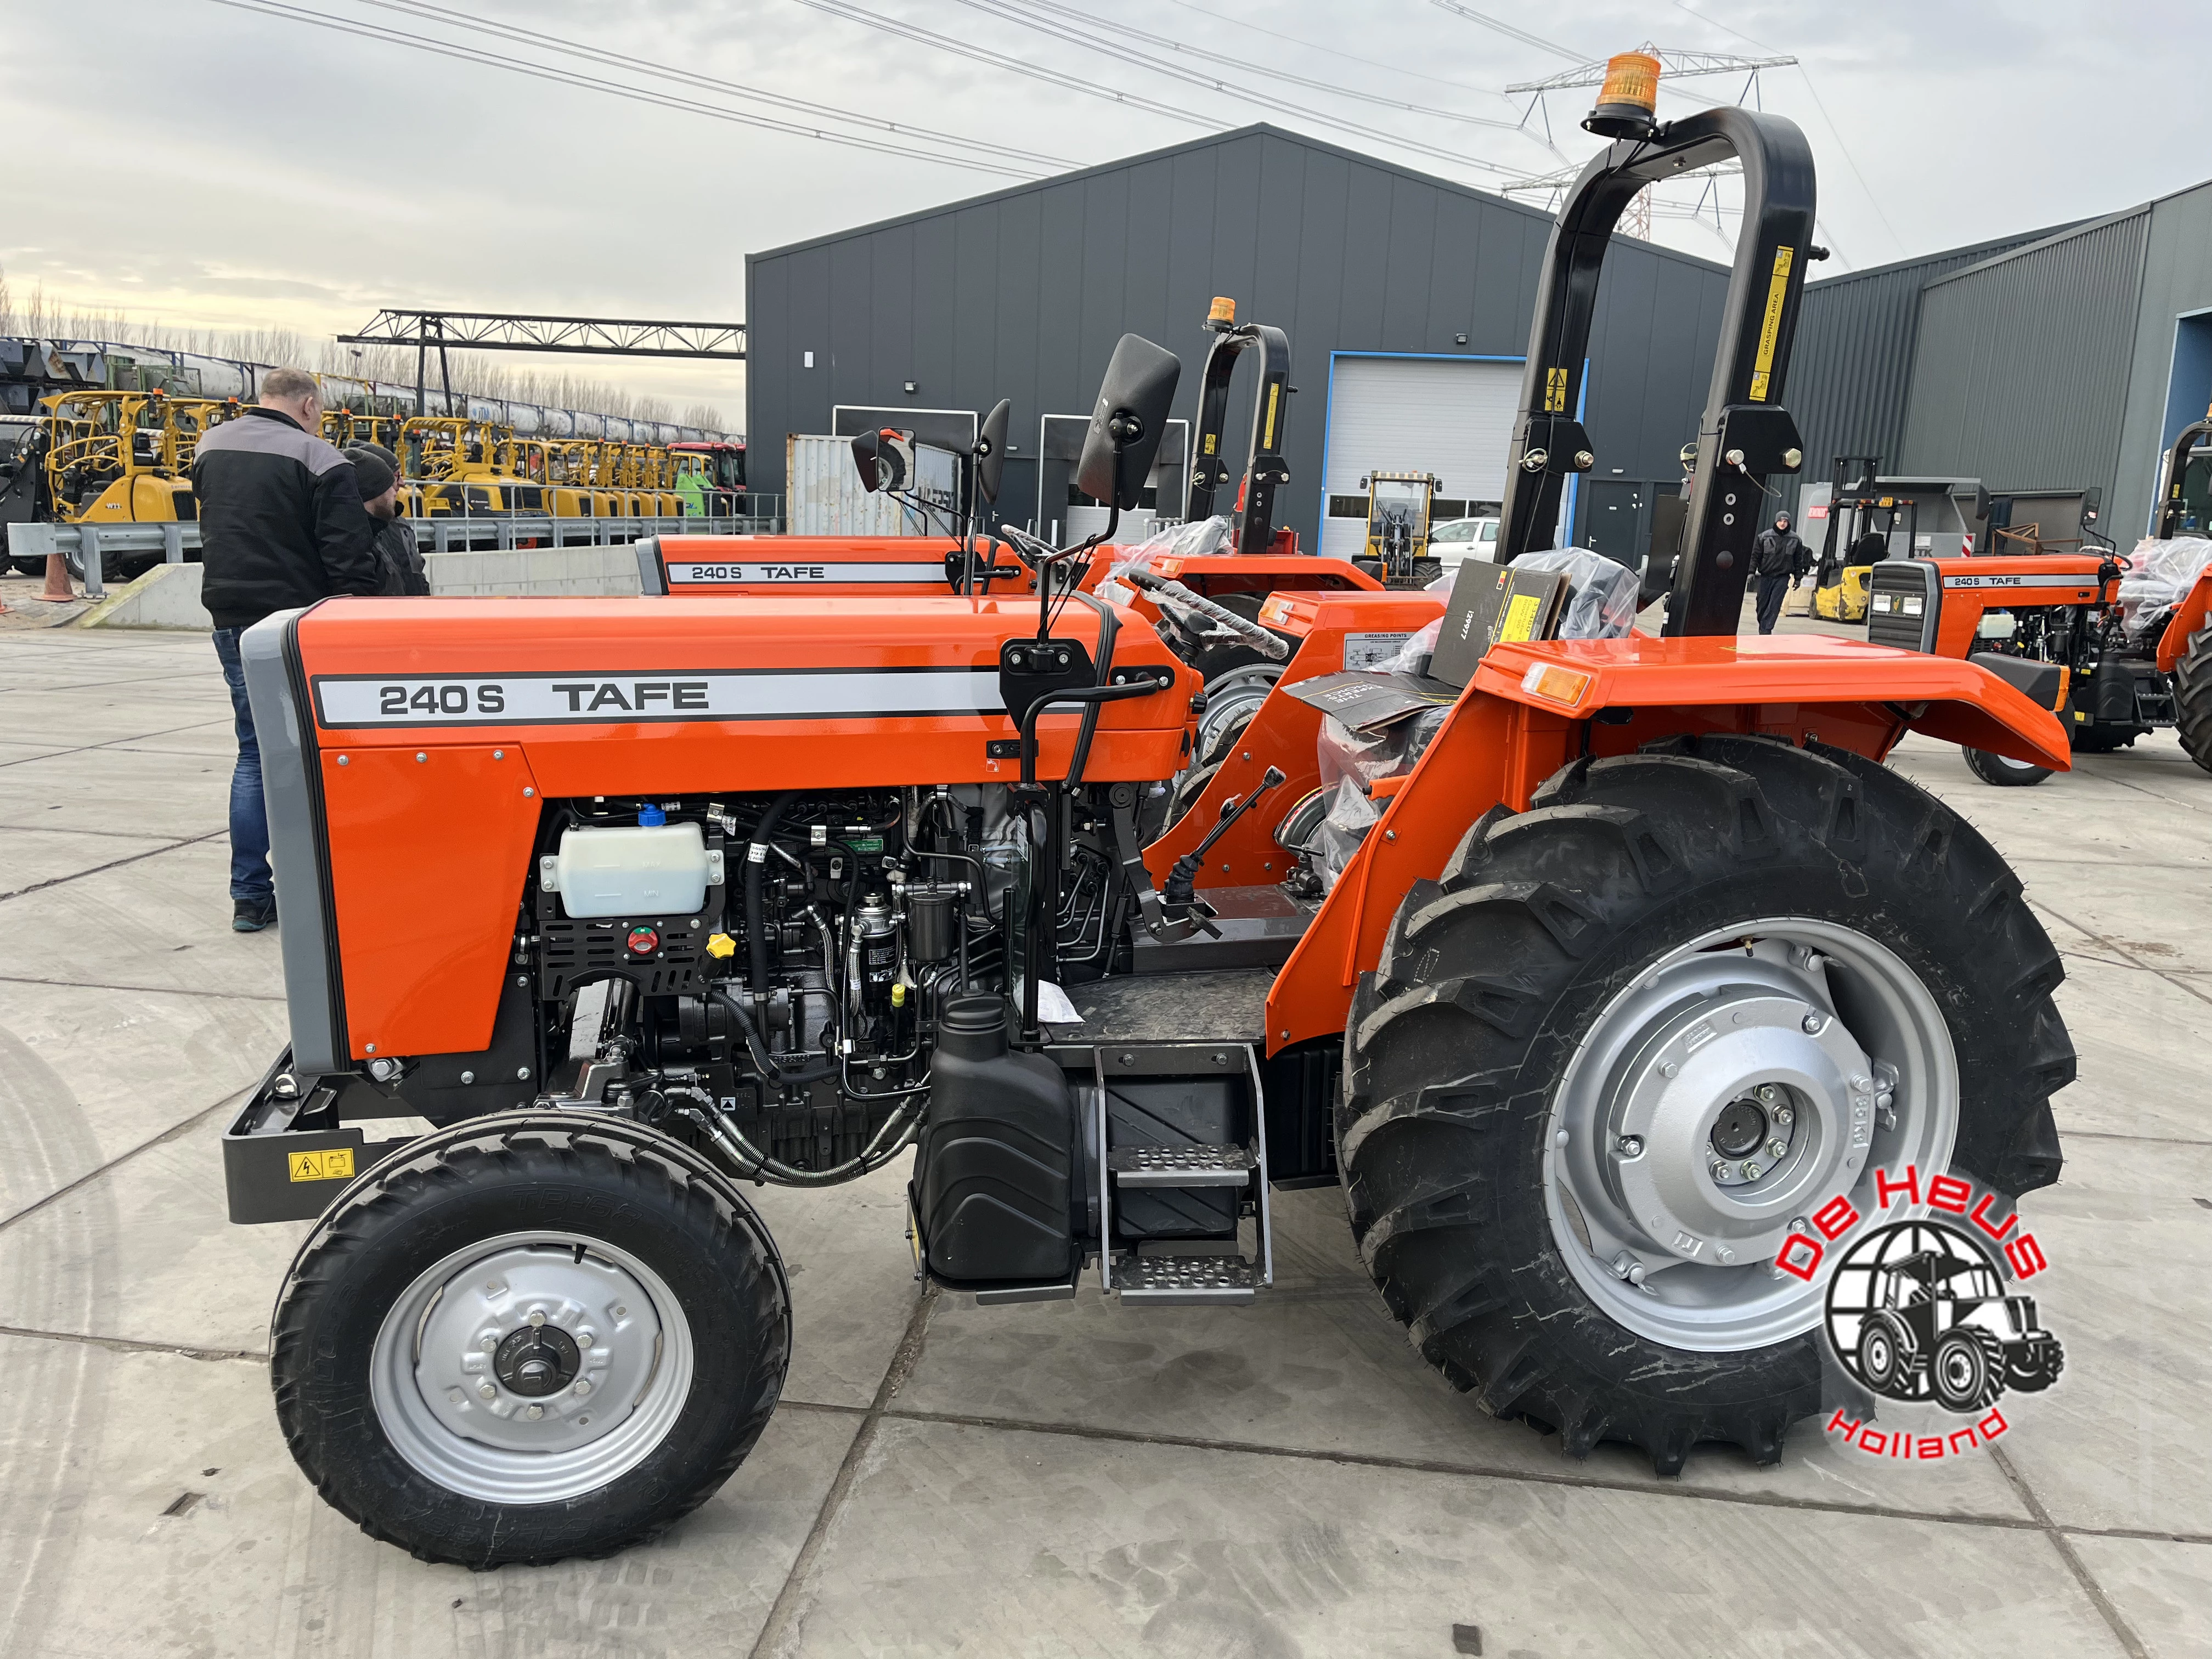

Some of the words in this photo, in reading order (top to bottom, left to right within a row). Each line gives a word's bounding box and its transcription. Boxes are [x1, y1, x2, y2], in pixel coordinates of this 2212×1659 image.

[1763, 315, 1775, 355] GRASPING
[760, 567, 824, 578] TAFE
[552, 682, 709, 712] TAFE
